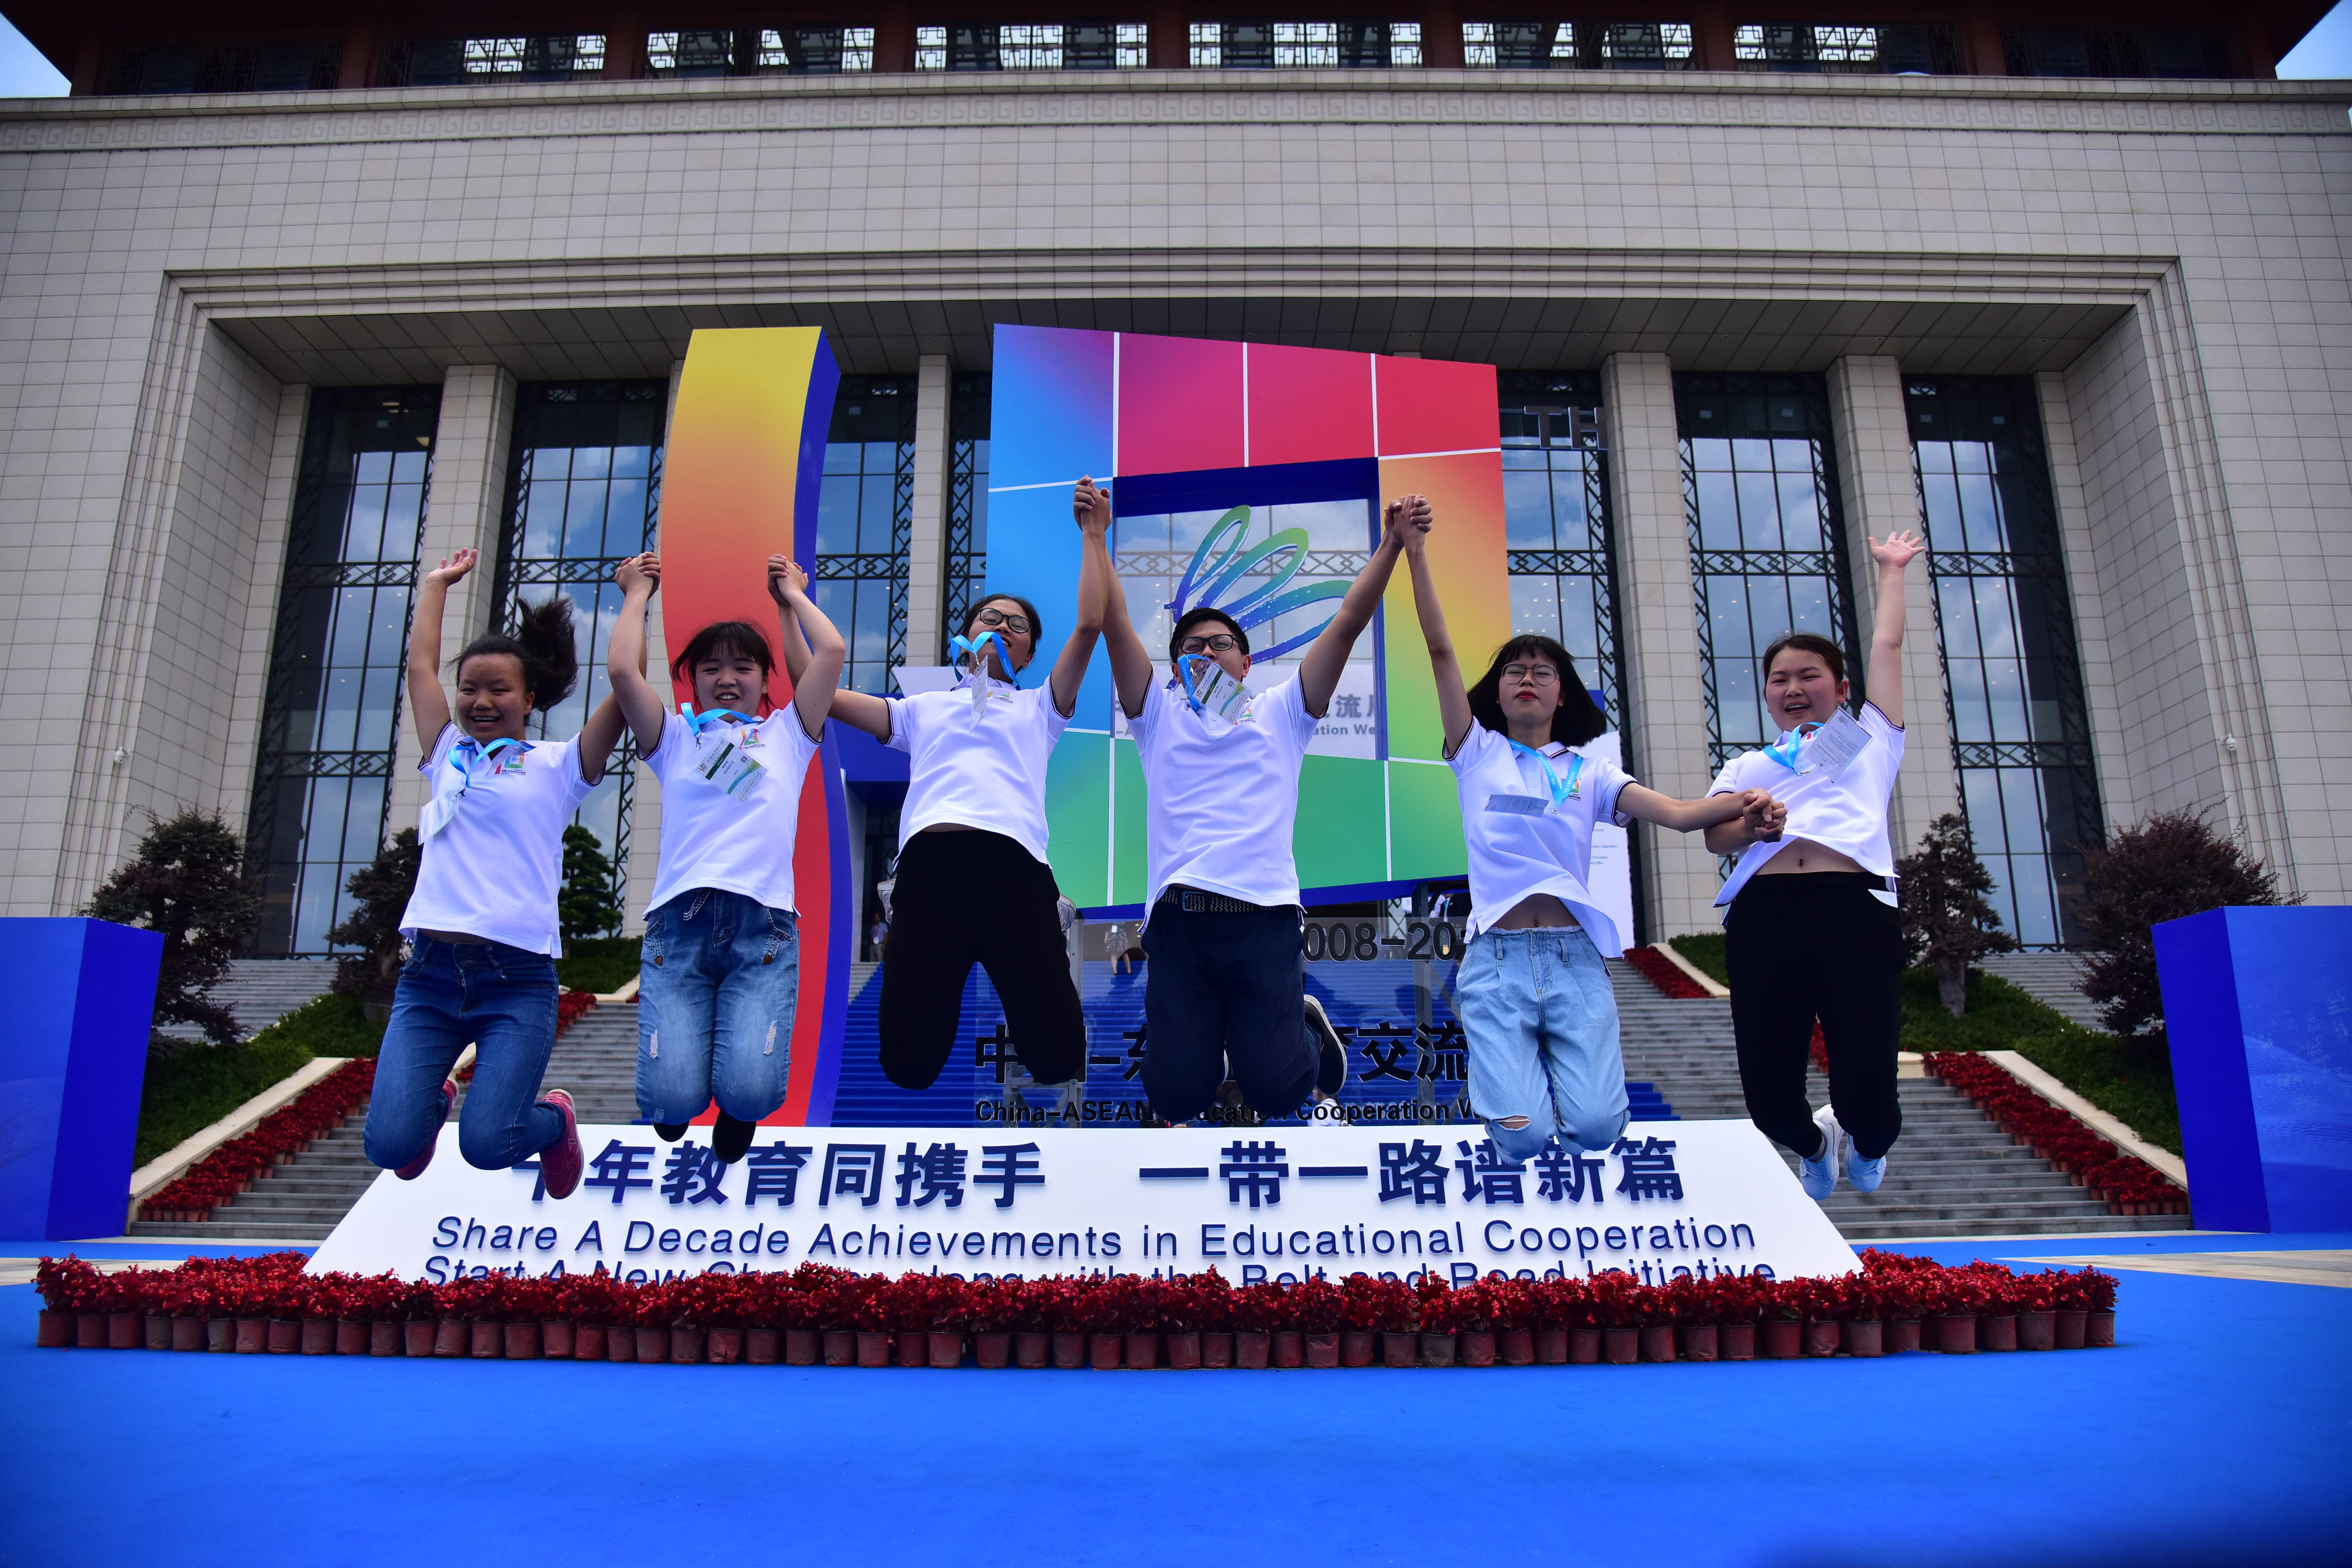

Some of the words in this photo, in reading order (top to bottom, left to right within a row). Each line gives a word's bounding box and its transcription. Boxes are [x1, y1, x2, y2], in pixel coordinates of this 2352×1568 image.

[1314, 724, 1348, 735] ation
[1353, 724, 1375, 735] We
[975, 1100, 1156, 1122] China-ASEAN
[1296, 1098, 1449, 1125] Cooperation
[432, 1216, 558, 1251] Share
[574, 1220, 603, 1253] A
[623, 1221, 789, 1255] Decade
[807, 1223, 1121, 1257] Achievements
[1144, 1224, 1177, 1257] in
[1201, 1221, 1464, 1257] Educational
[1484, 1217, 1755, 1260] Cooperation
[1588, 1257, 1776, 1287] itiative
